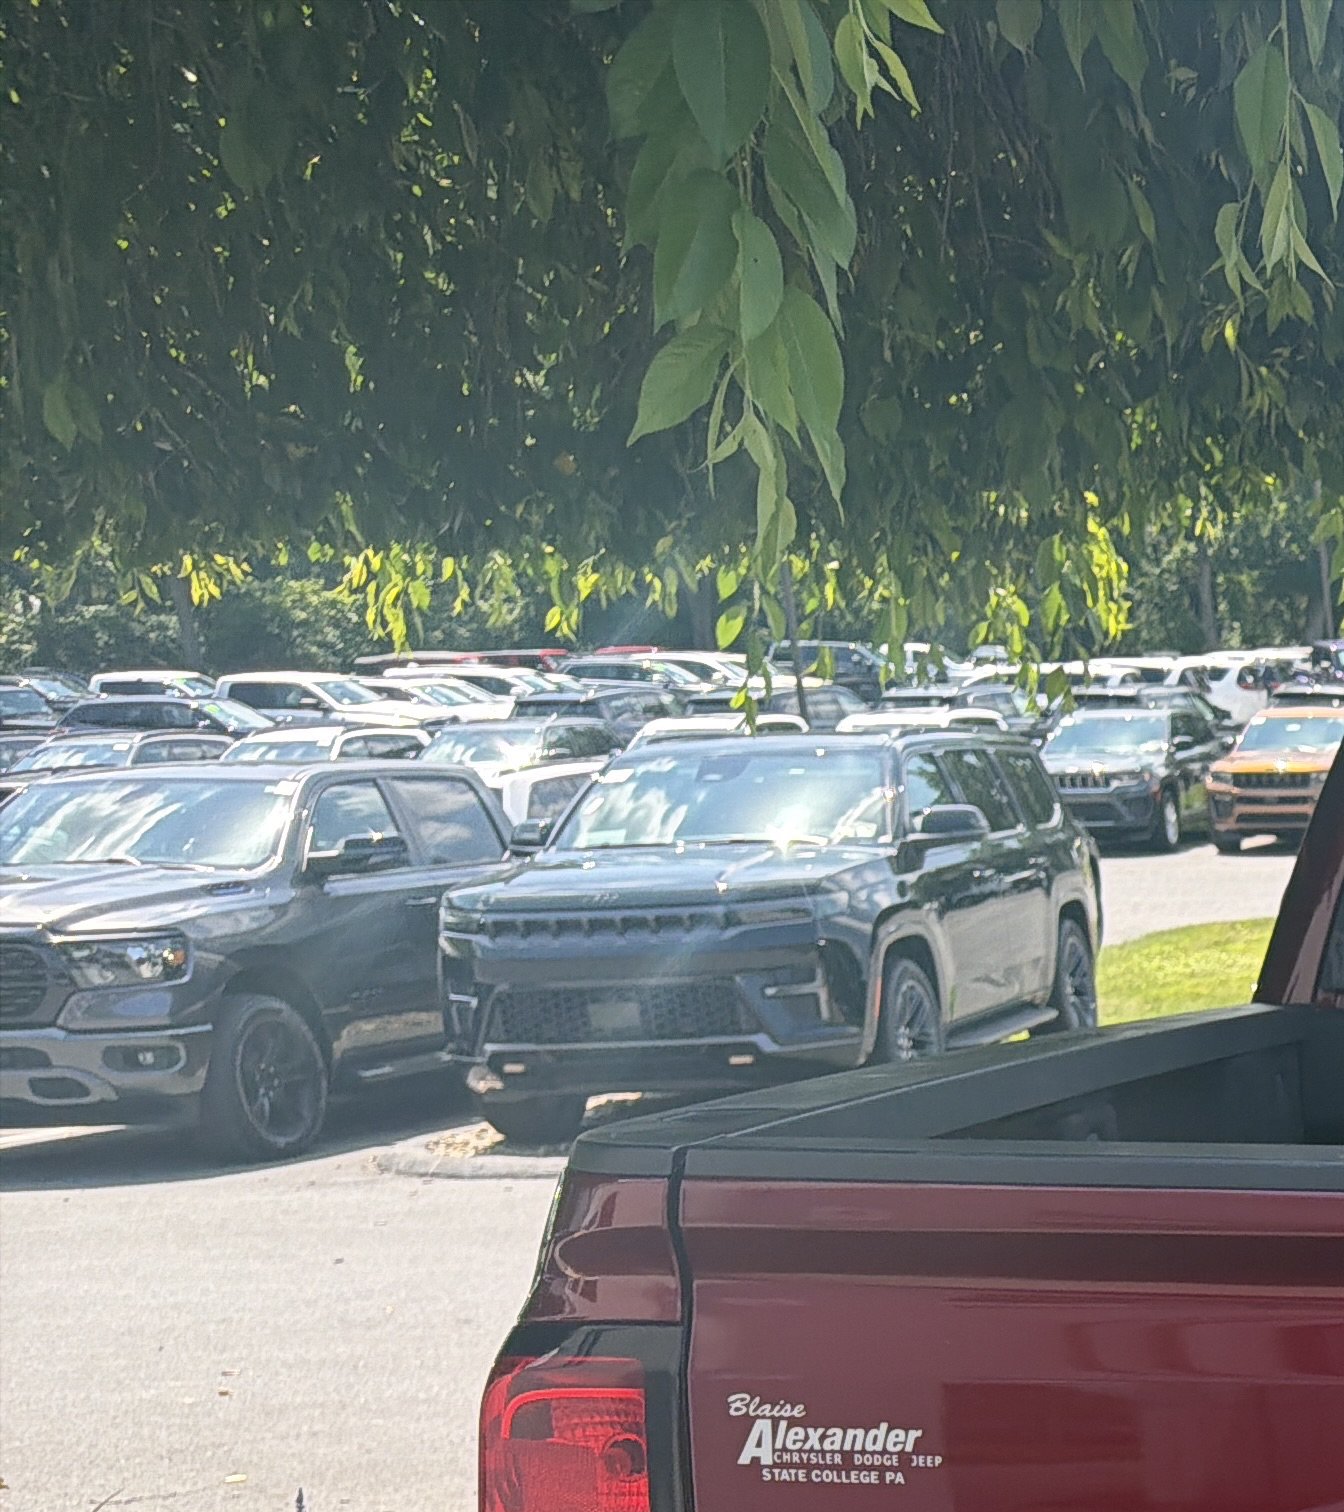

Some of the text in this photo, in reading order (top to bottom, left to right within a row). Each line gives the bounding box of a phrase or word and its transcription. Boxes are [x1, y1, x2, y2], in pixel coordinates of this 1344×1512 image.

[727, 1393, 806, 1418] Blaise
[737, 1419, 922, 1465] Alexander
[774, 1451, 943, 1467] CHRYSLER DODGE JEEP
[762, 1468, 905, 1484] STATE COLLEGE PA
